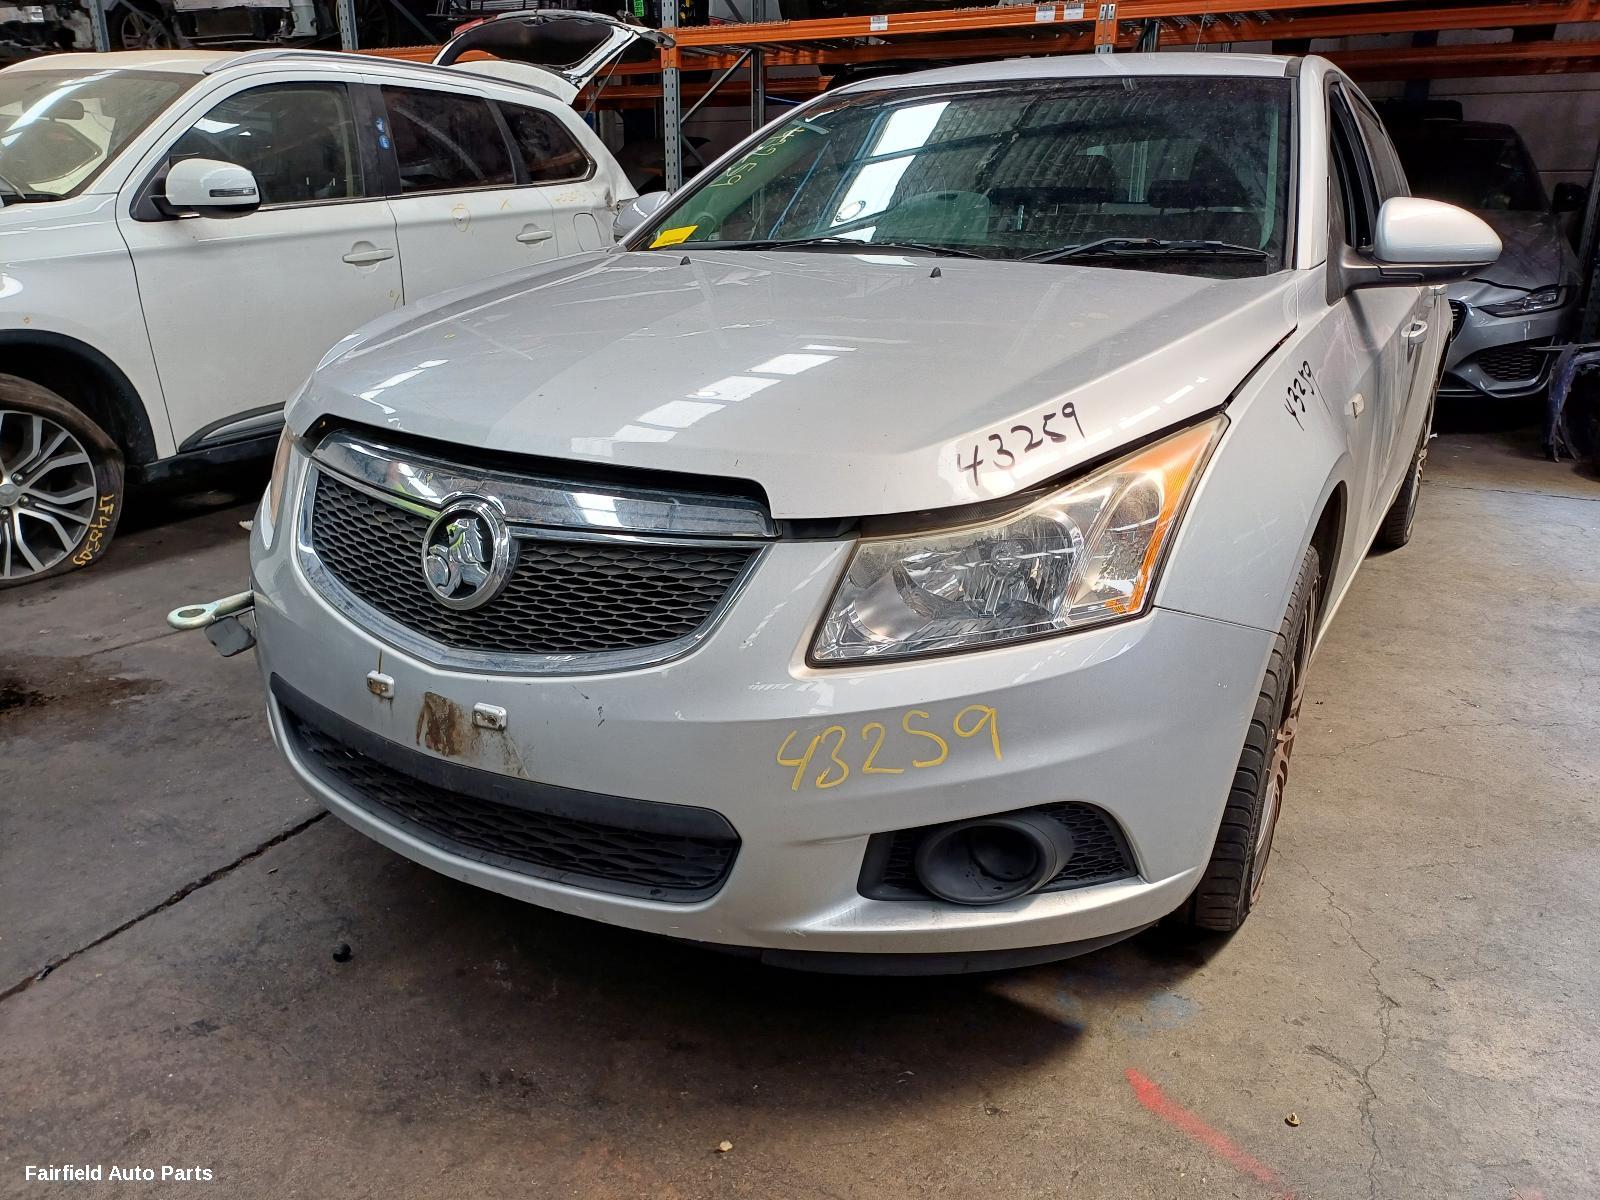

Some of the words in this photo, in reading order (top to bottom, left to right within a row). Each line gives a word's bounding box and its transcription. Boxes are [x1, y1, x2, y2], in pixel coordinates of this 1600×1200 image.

[1284, 360, 1331, 431] 43259
[957, 402, 1085, 486] 43259
[776, 704, 1003, 791] 43259
